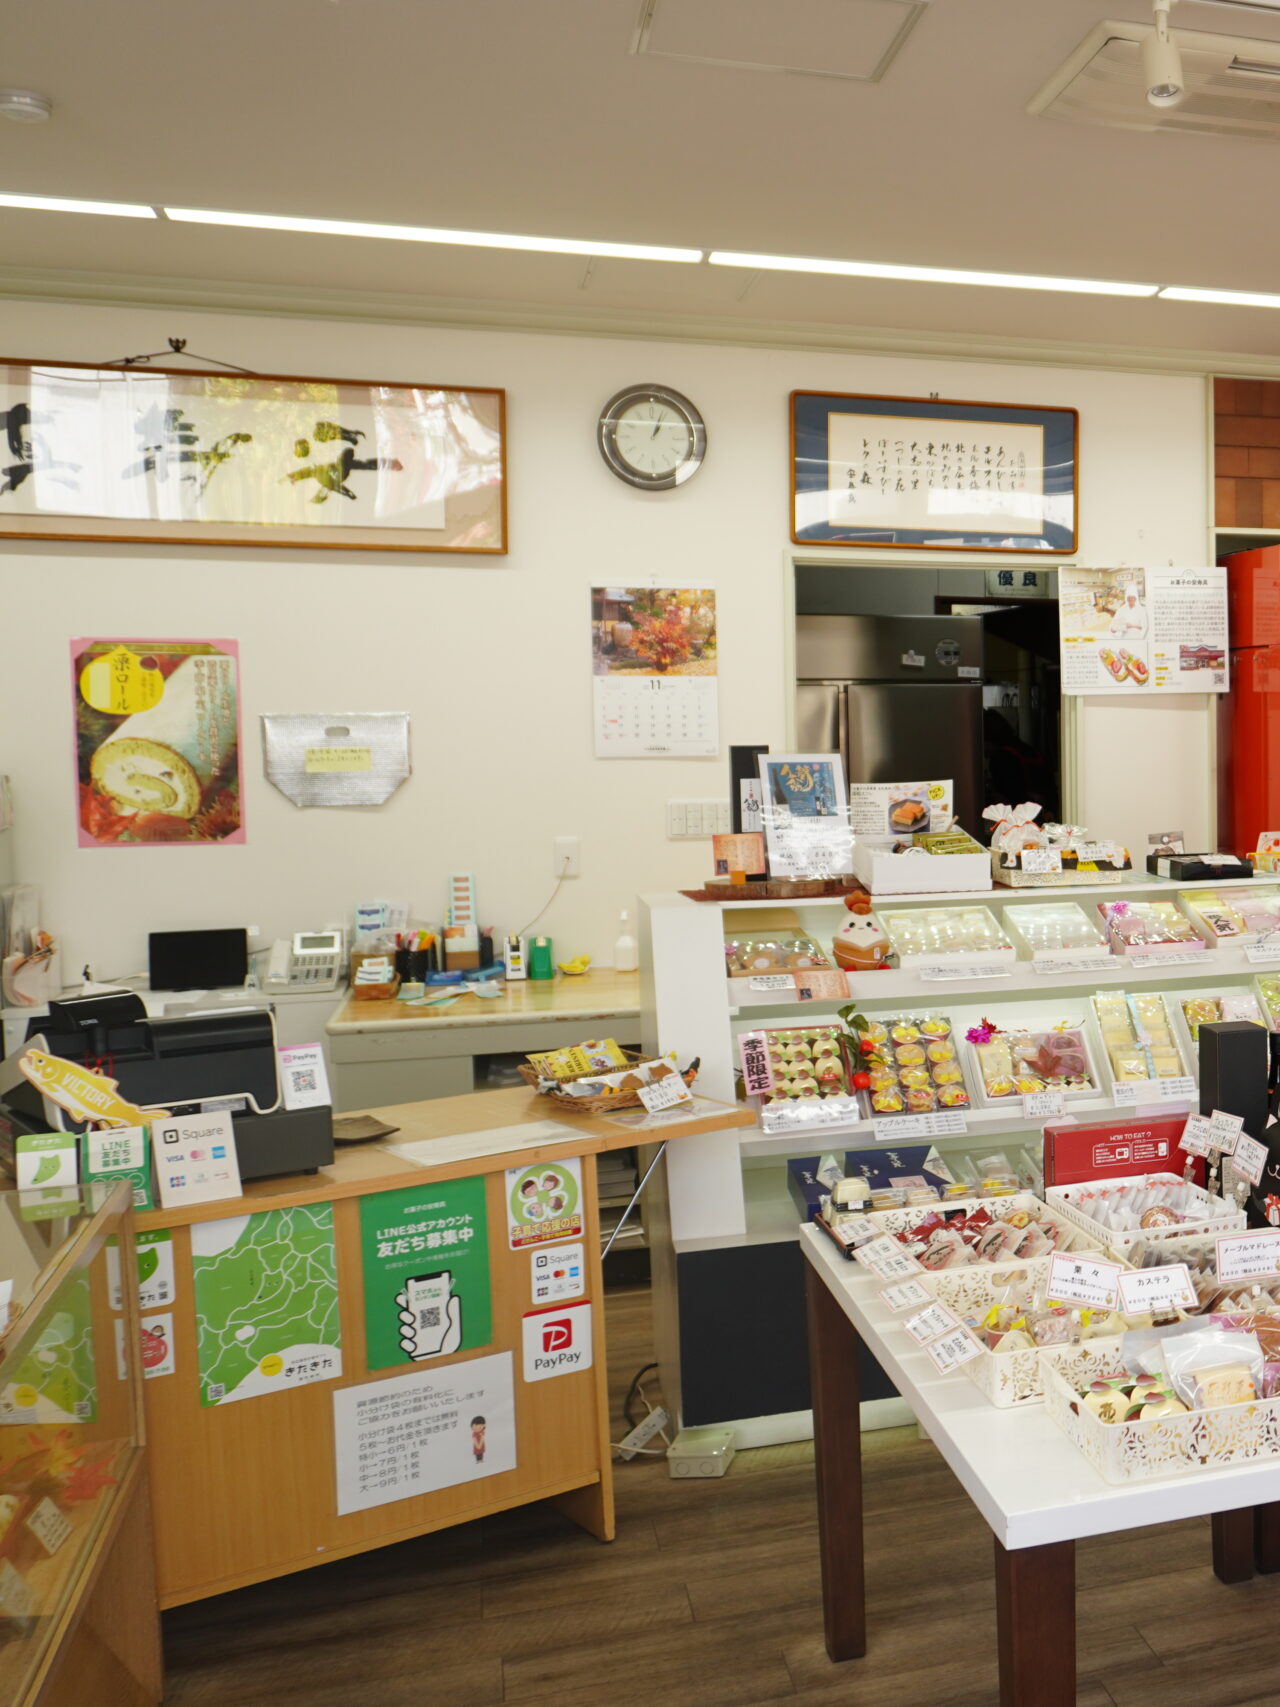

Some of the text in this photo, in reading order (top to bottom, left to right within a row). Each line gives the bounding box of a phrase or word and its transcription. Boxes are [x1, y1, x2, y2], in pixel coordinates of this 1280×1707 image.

[998, 570, 1038, 587] 優良
[743, 1038, 770, 1091] 季節限定
[61, 1072, 116, 1110] VICTORY
[182, 1126, 224, 1141] Square
[101, 1139, 131, 1151] LINE
[101, 1149, 131, 1160] 友だち
[166, 1154, 185, 1163] VISA
[101, 1158, 131, 1168] 募集中
[376, 1213, 473, 1240] LINE公式アカウント
[512, 1215, 580, 1240] 子育て応援の店
[376, 1226, 474, 1258] 友だち募集中
[1223, 1240, 1280, 1254] メープルマドレーヌ
[549, 1252, 579, 1264] Square
[1137, 1275, 1170, 1287] カステラ
[284, 1358, 333, 1378] きたきた
[534, 1351, 582, 1370] PayPay
